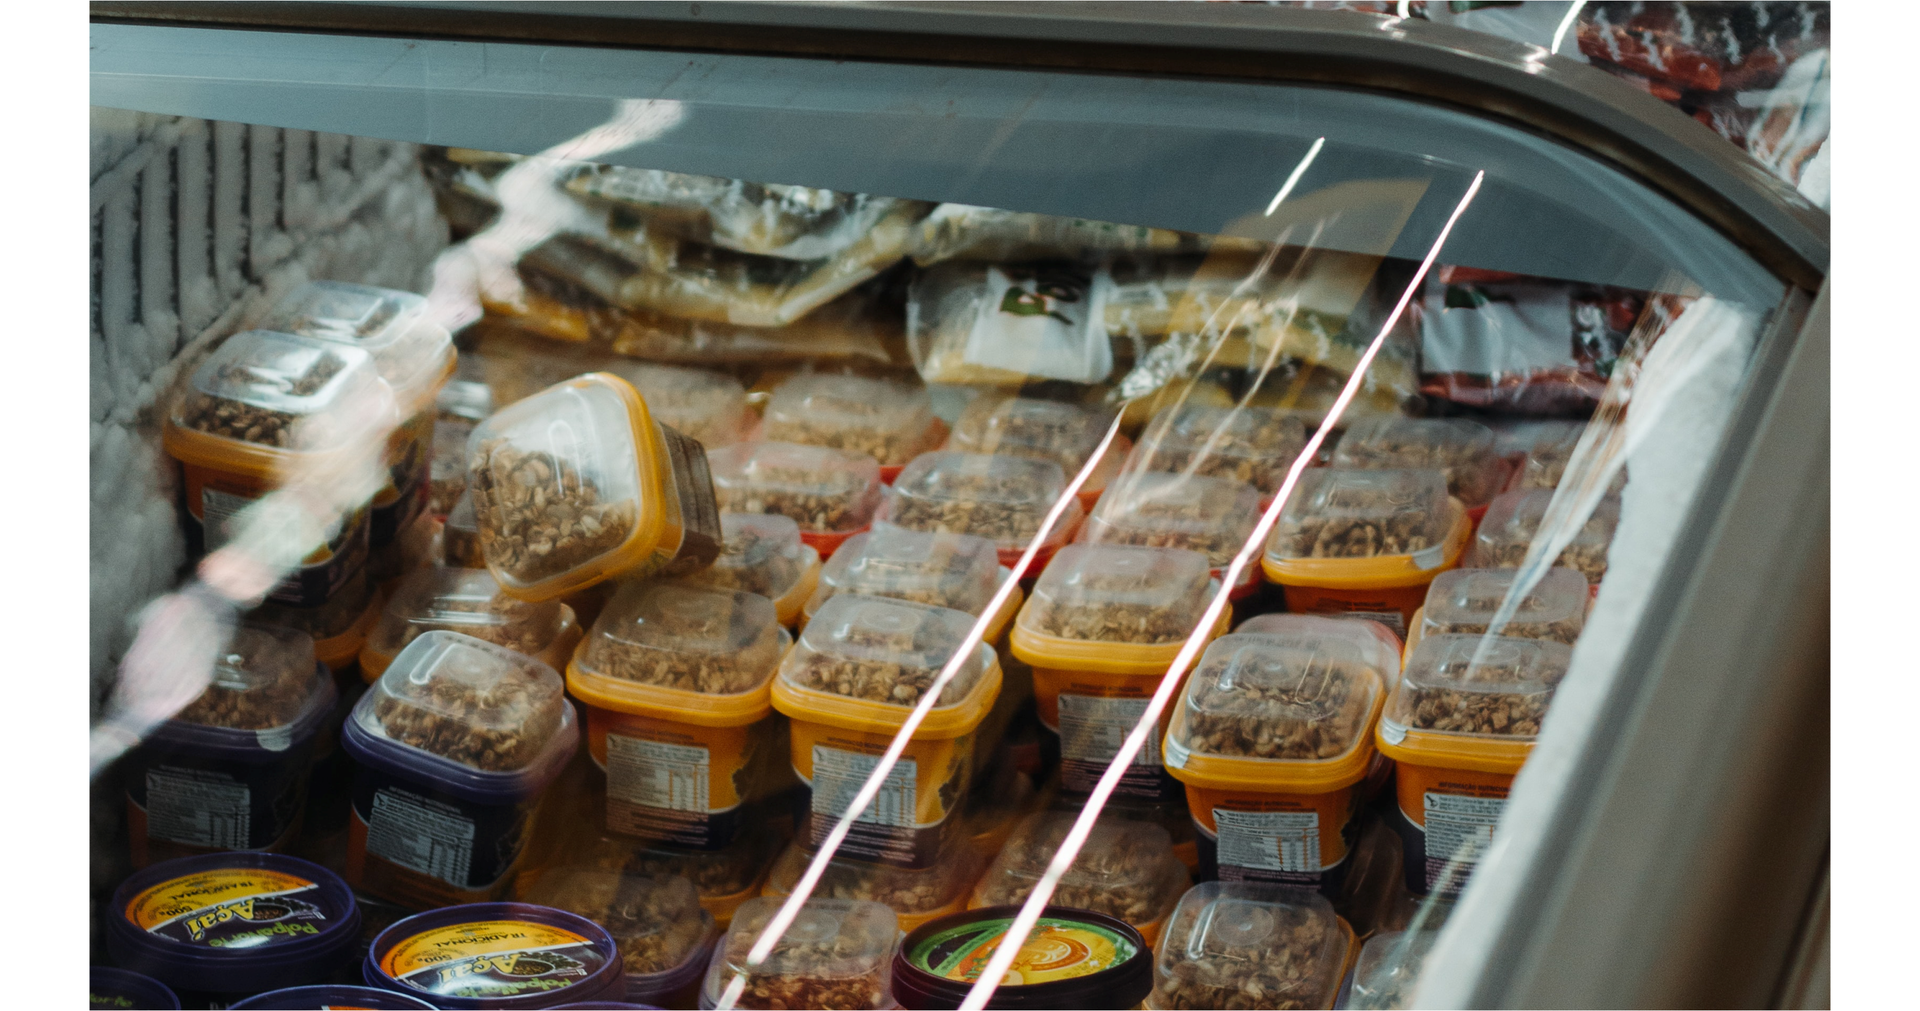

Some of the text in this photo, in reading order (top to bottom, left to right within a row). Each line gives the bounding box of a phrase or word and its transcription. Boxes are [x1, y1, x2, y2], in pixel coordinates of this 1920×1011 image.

[170, 881, 255, 900] TRADICIONAL
[184, 898, 255, 942] Açaí
[432, 932, 528, 949] TRADICIONAL
